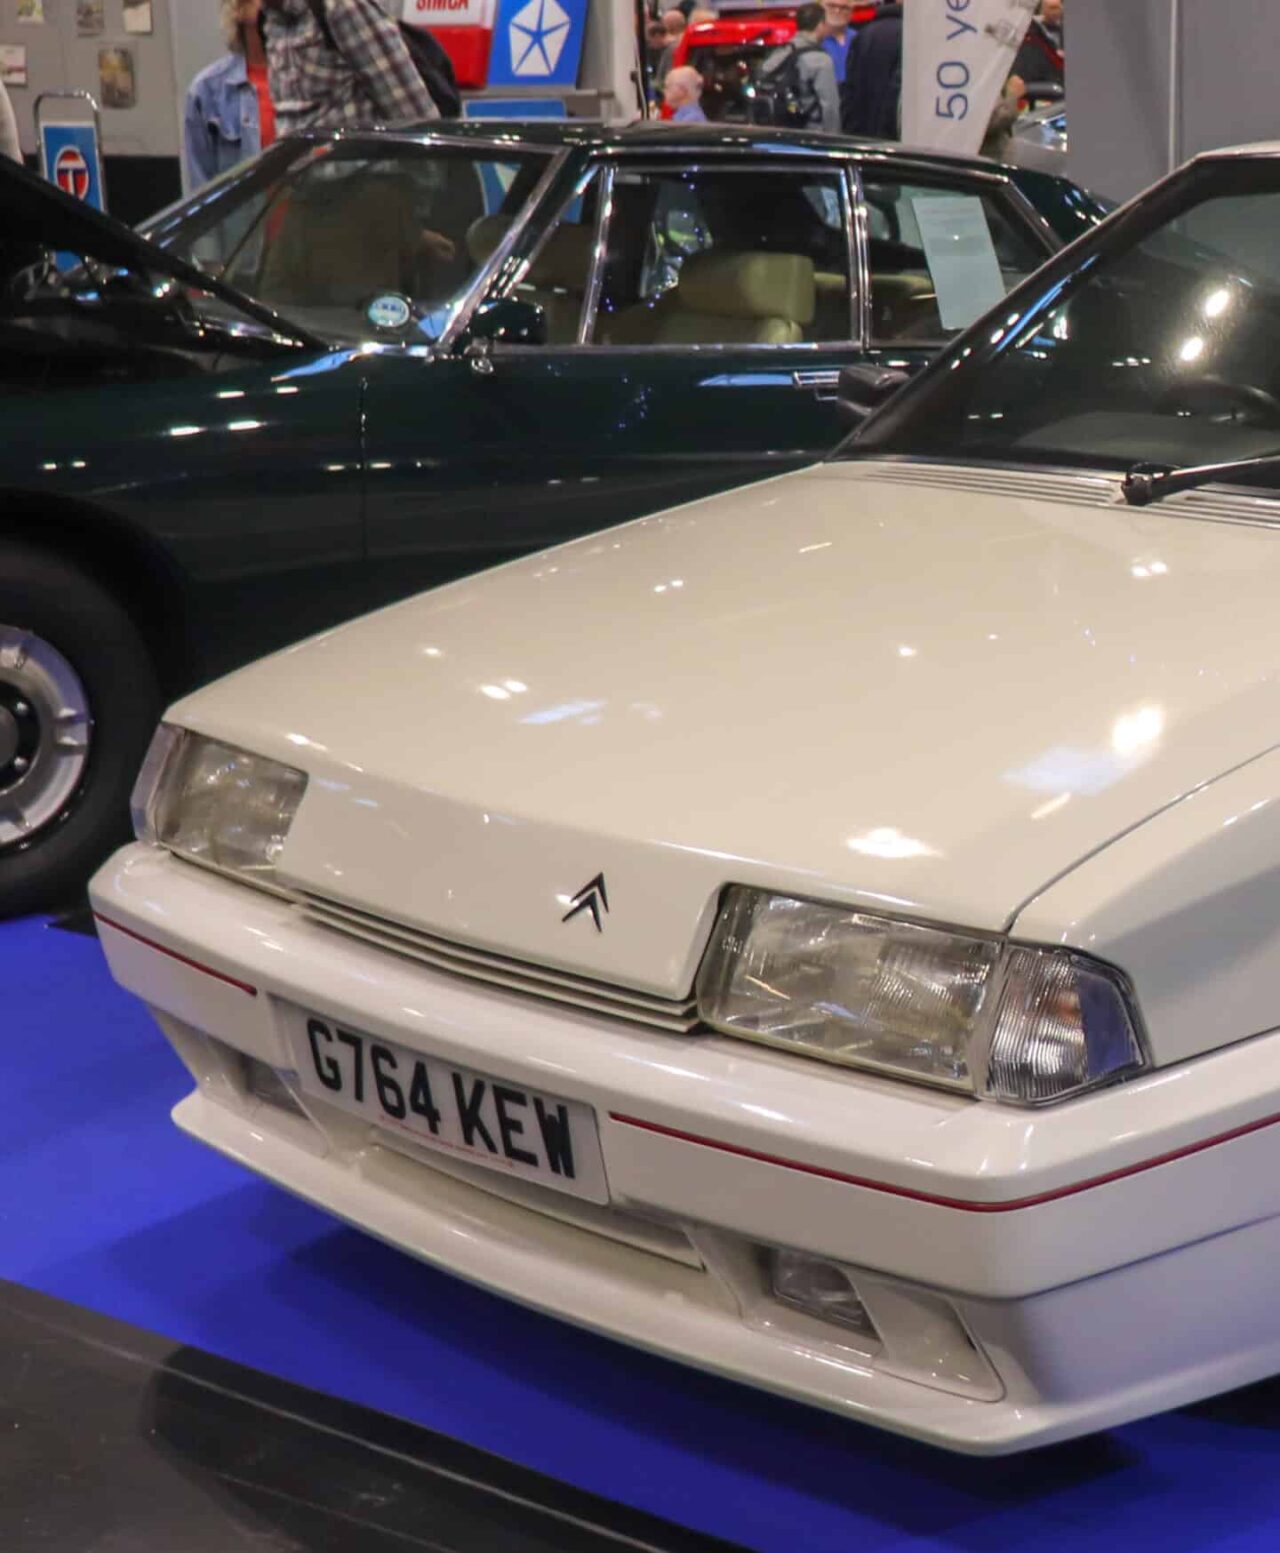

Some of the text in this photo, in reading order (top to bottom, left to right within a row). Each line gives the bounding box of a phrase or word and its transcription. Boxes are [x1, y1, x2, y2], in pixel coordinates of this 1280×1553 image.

[936, 61, 970, 120] 50
[306, 1018, 441, 1135] G764
[453, 1072, 575, 1179] KEW
